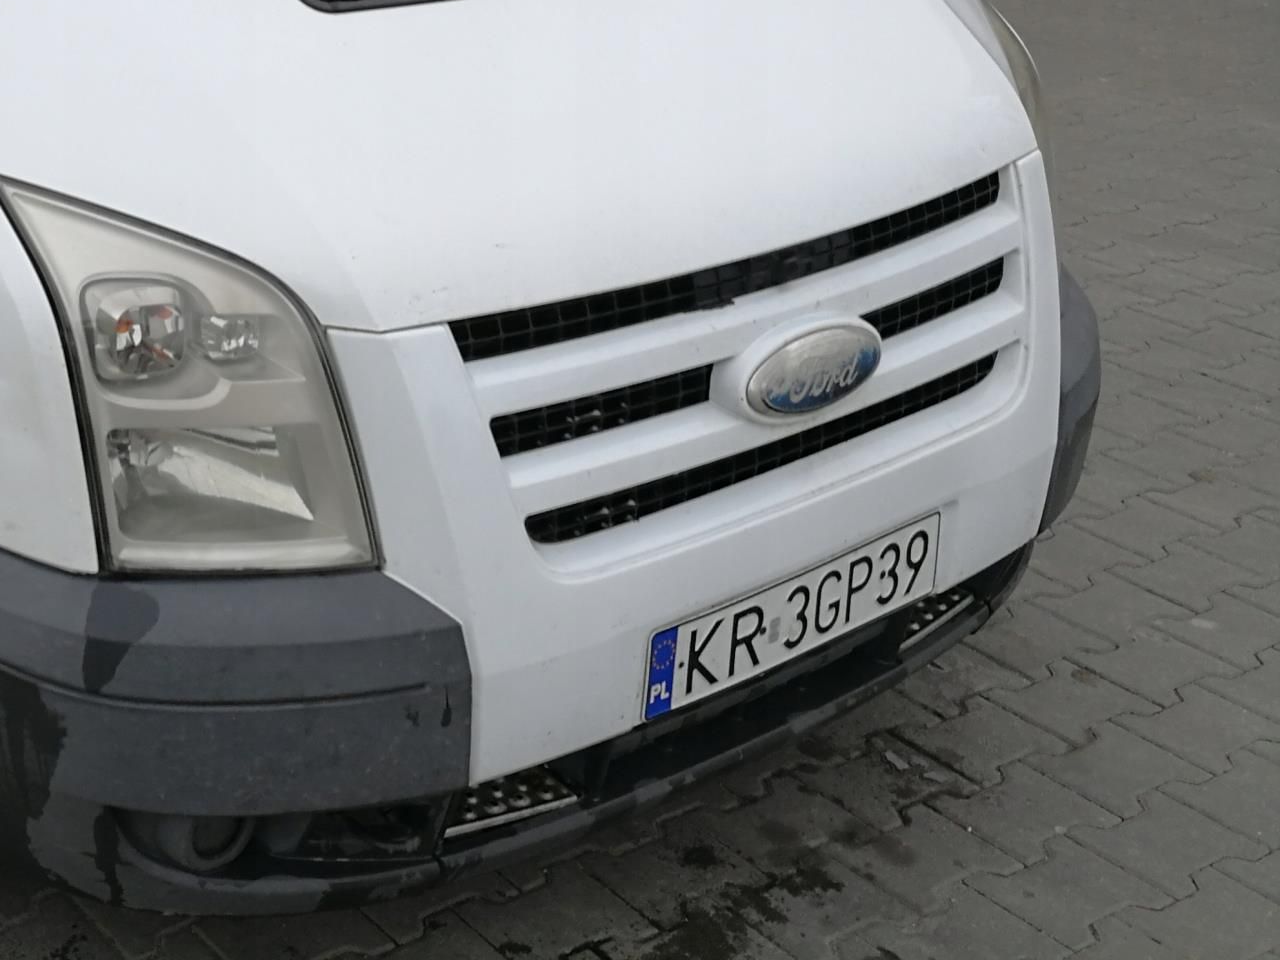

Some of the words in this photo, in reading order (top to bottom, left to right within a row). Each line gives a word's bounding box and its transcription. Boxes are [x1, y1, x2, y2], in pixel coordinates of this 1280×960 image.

[770, 351, 859, 404] Ford
[685, 606, 765, 695] KR
[783, 529, 930, 649] 3GP39
[649, 680, 670, 704] PL
